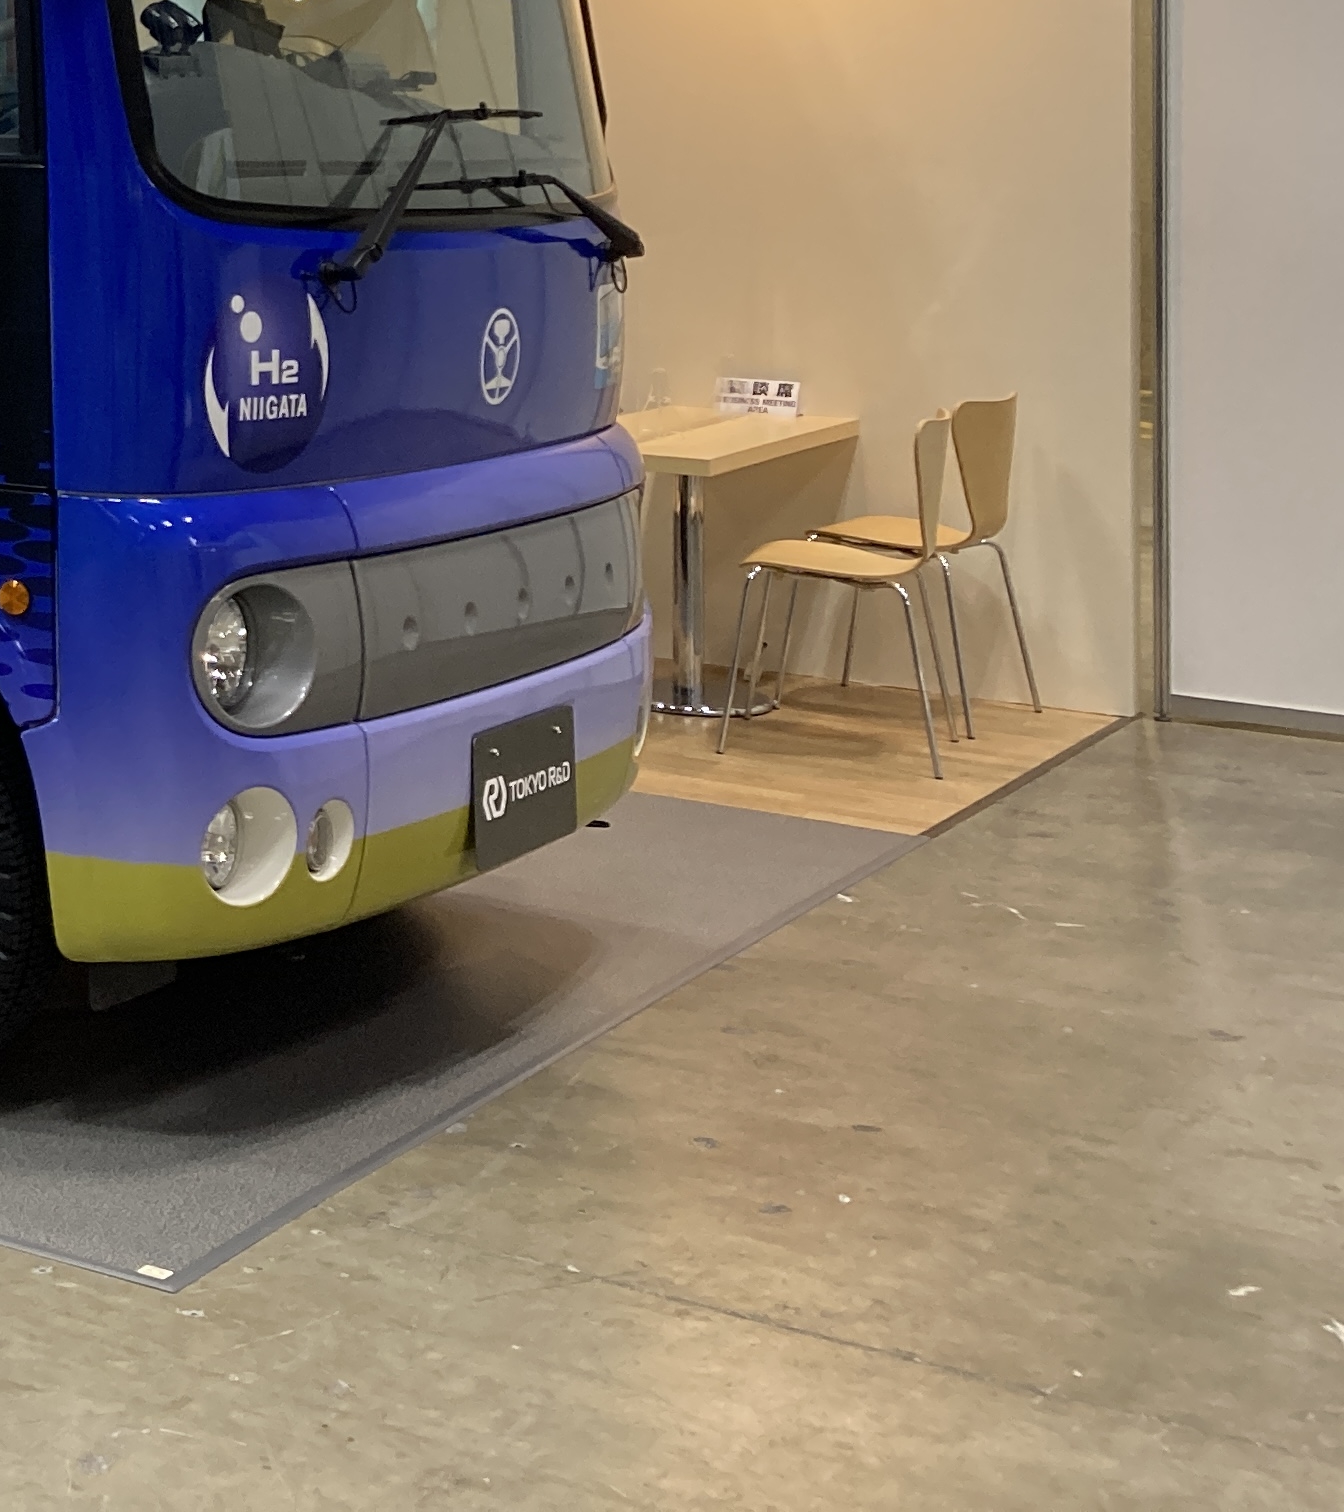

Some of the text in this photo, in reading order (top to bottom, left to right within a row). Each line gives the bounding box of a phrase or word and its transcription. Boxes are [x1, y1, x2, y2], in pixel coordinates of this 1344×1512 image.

[249, 349, 299, 386] H2
[239, 393, 308, 422] NIIGATA
[508, 761, 571, 802] TOKYO R&D
